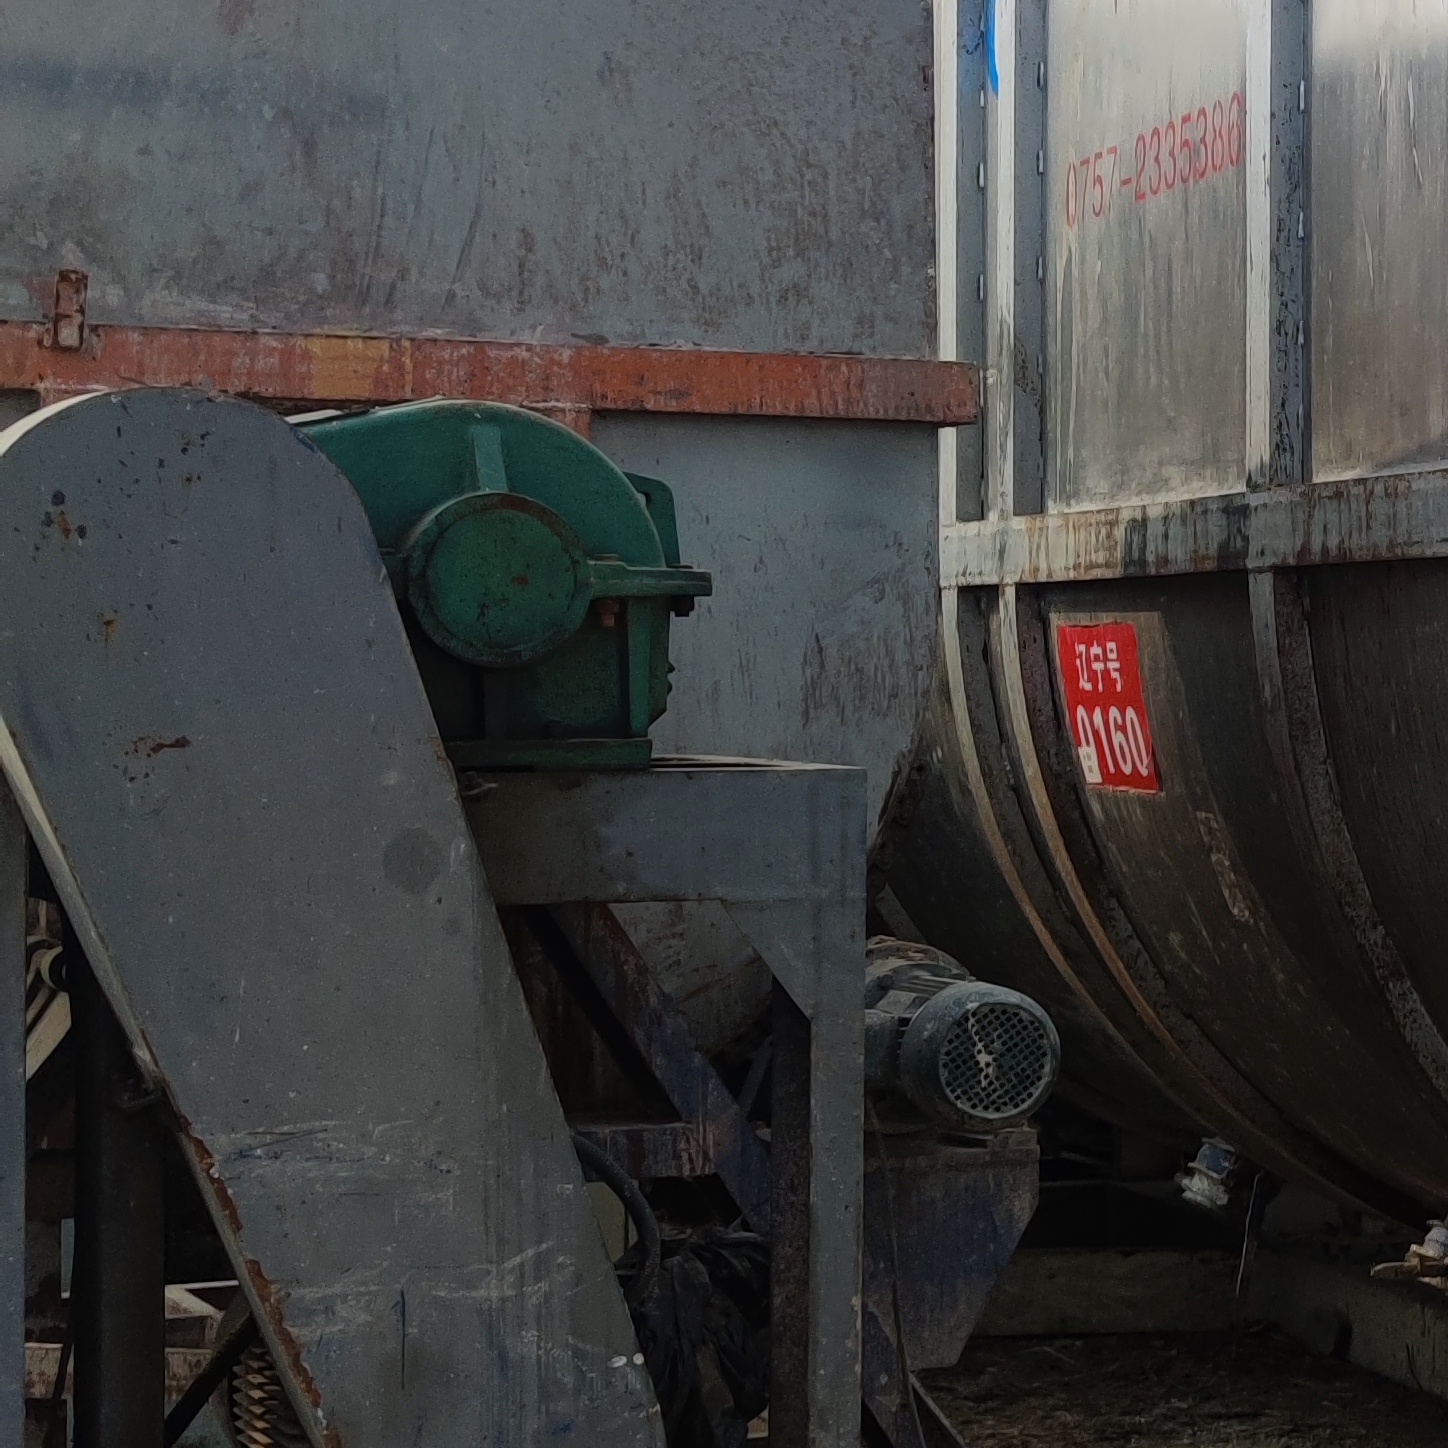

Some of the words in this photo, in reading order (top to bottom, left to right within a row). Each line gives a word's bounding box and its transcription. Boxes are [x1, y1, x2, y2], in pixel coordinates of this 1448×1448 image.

[1075, 640, 1123, 693] 辽宁号
[1077, 704, 1149, 777] 0160
